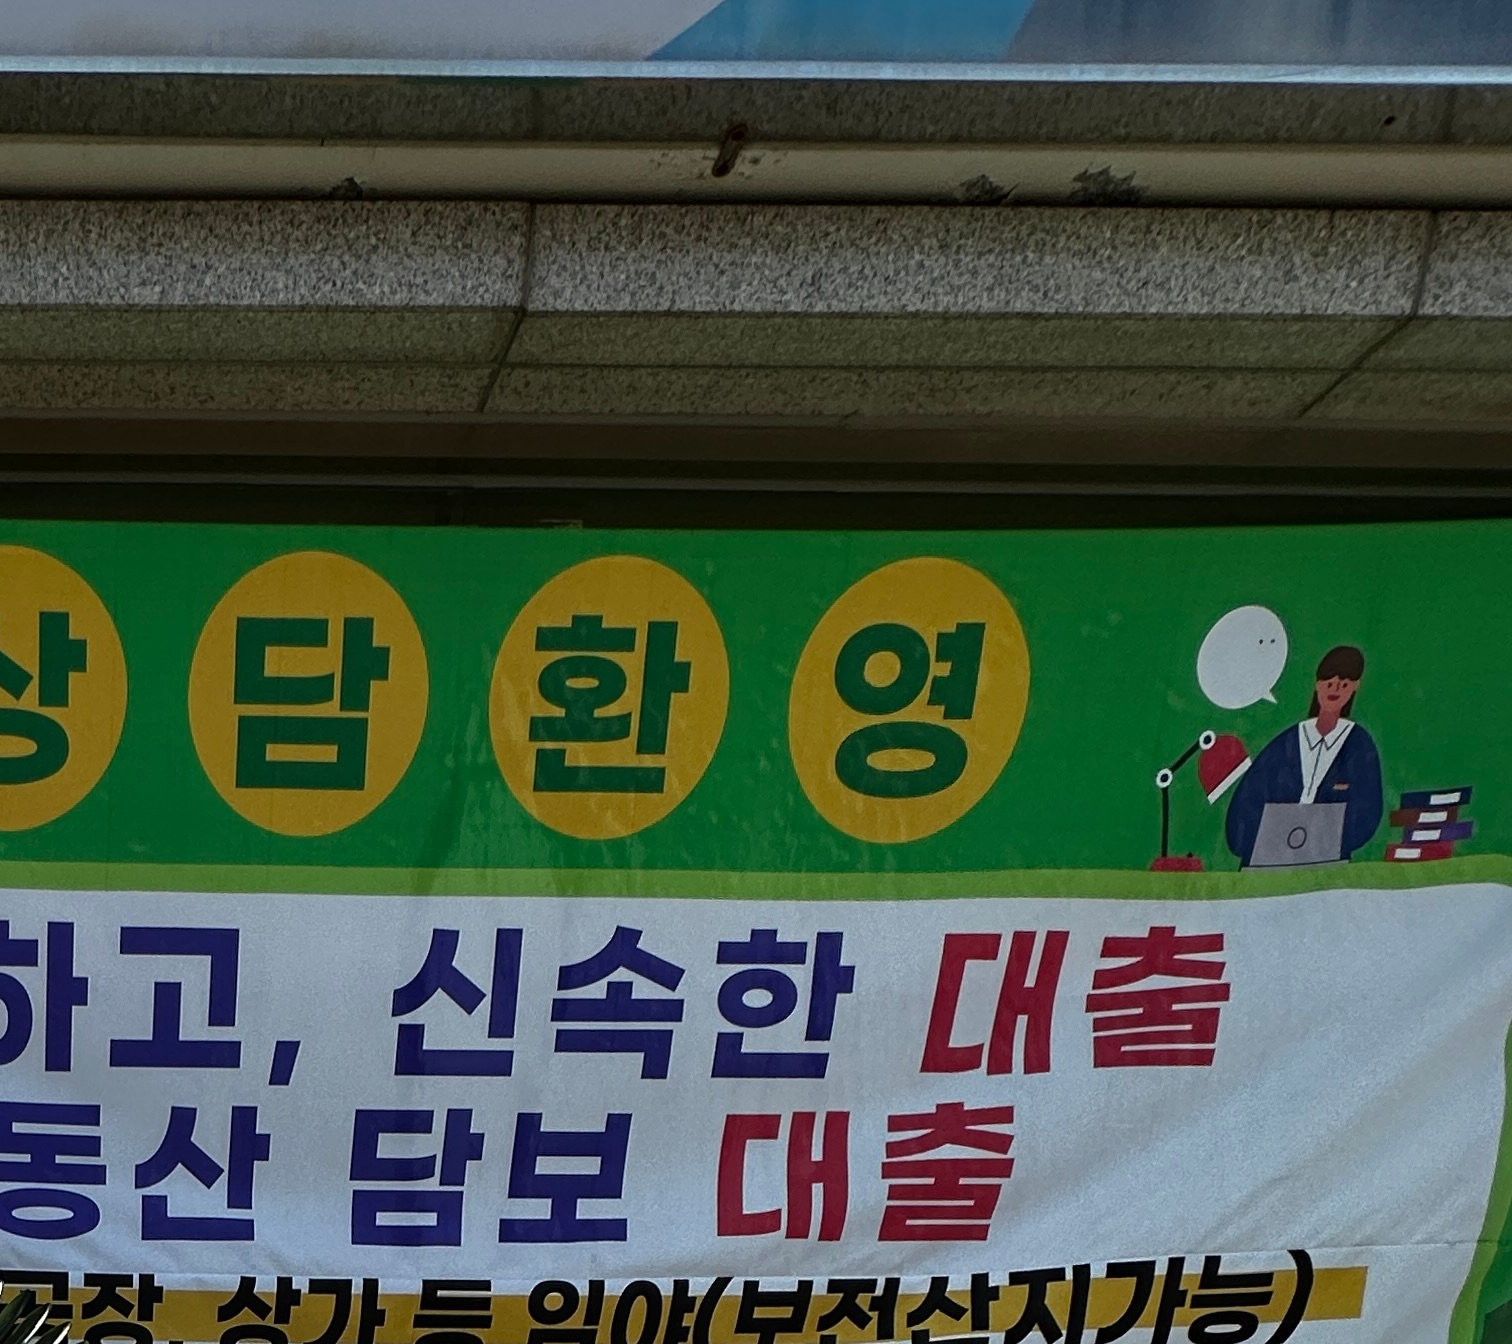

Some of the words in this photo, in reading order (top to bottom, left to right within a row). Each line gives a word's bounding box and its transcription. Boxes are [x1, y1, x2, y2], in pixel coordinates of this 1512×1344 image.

[391, 925, 855, 1080] 신속한
[918, 925, 1231, 1075] 대출
[348, 1107, 633, 1247] 담보
[716, 1102, 1015, 1243] 대출
